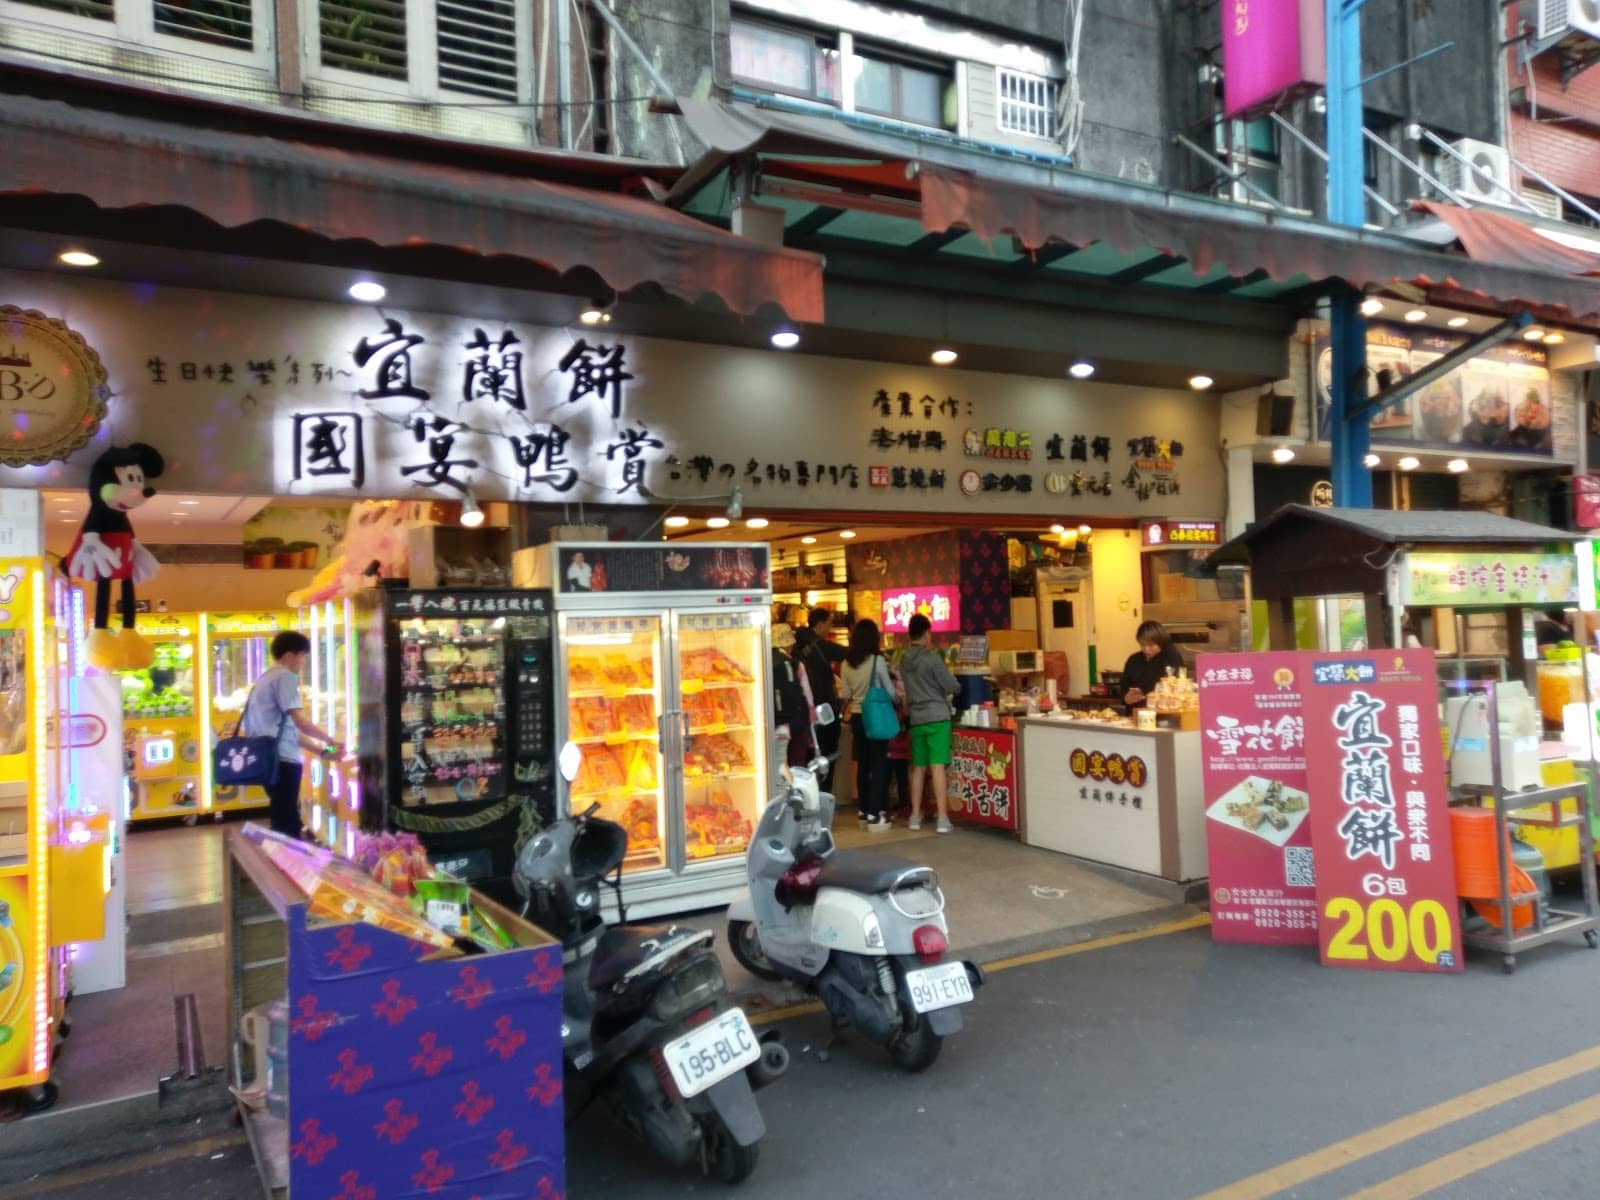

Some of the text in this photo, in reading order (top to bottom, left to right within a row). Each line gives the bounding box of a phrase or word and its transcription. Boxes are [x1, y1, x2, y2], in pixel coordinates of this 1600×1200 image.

[353, 318, 634, 418] 宜蘭餅
[292, 408, 665, 500] 國宴鴨賞
[1331, 690, 1405, 871] 宜蘭餅
[1362, 873, 1408, 897] 6包
[678, 1028, 753, 1084] 195-BLC
